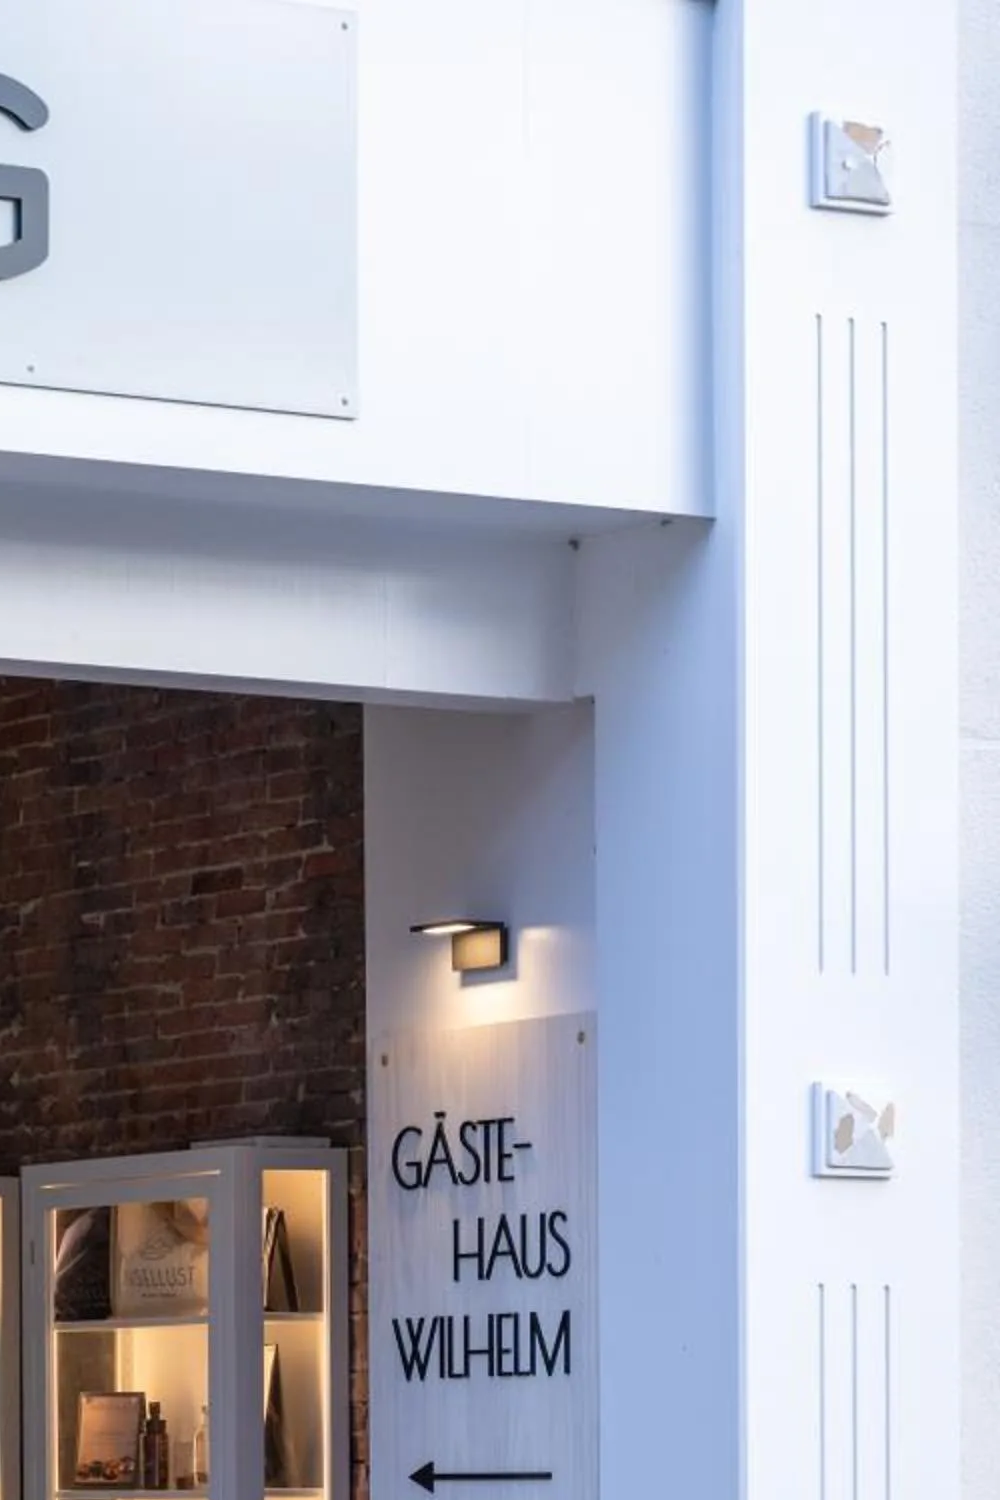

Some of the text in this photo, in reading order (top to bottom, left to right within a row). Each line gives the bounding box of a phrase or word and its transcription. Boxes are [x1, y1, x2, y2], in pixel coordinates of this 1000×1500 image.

[392, 1111, 532, 1190] GÄSTE-
[453, 1210, 571, 1282] HAUS
[392, 1310, 570, 1382] WILHELM
